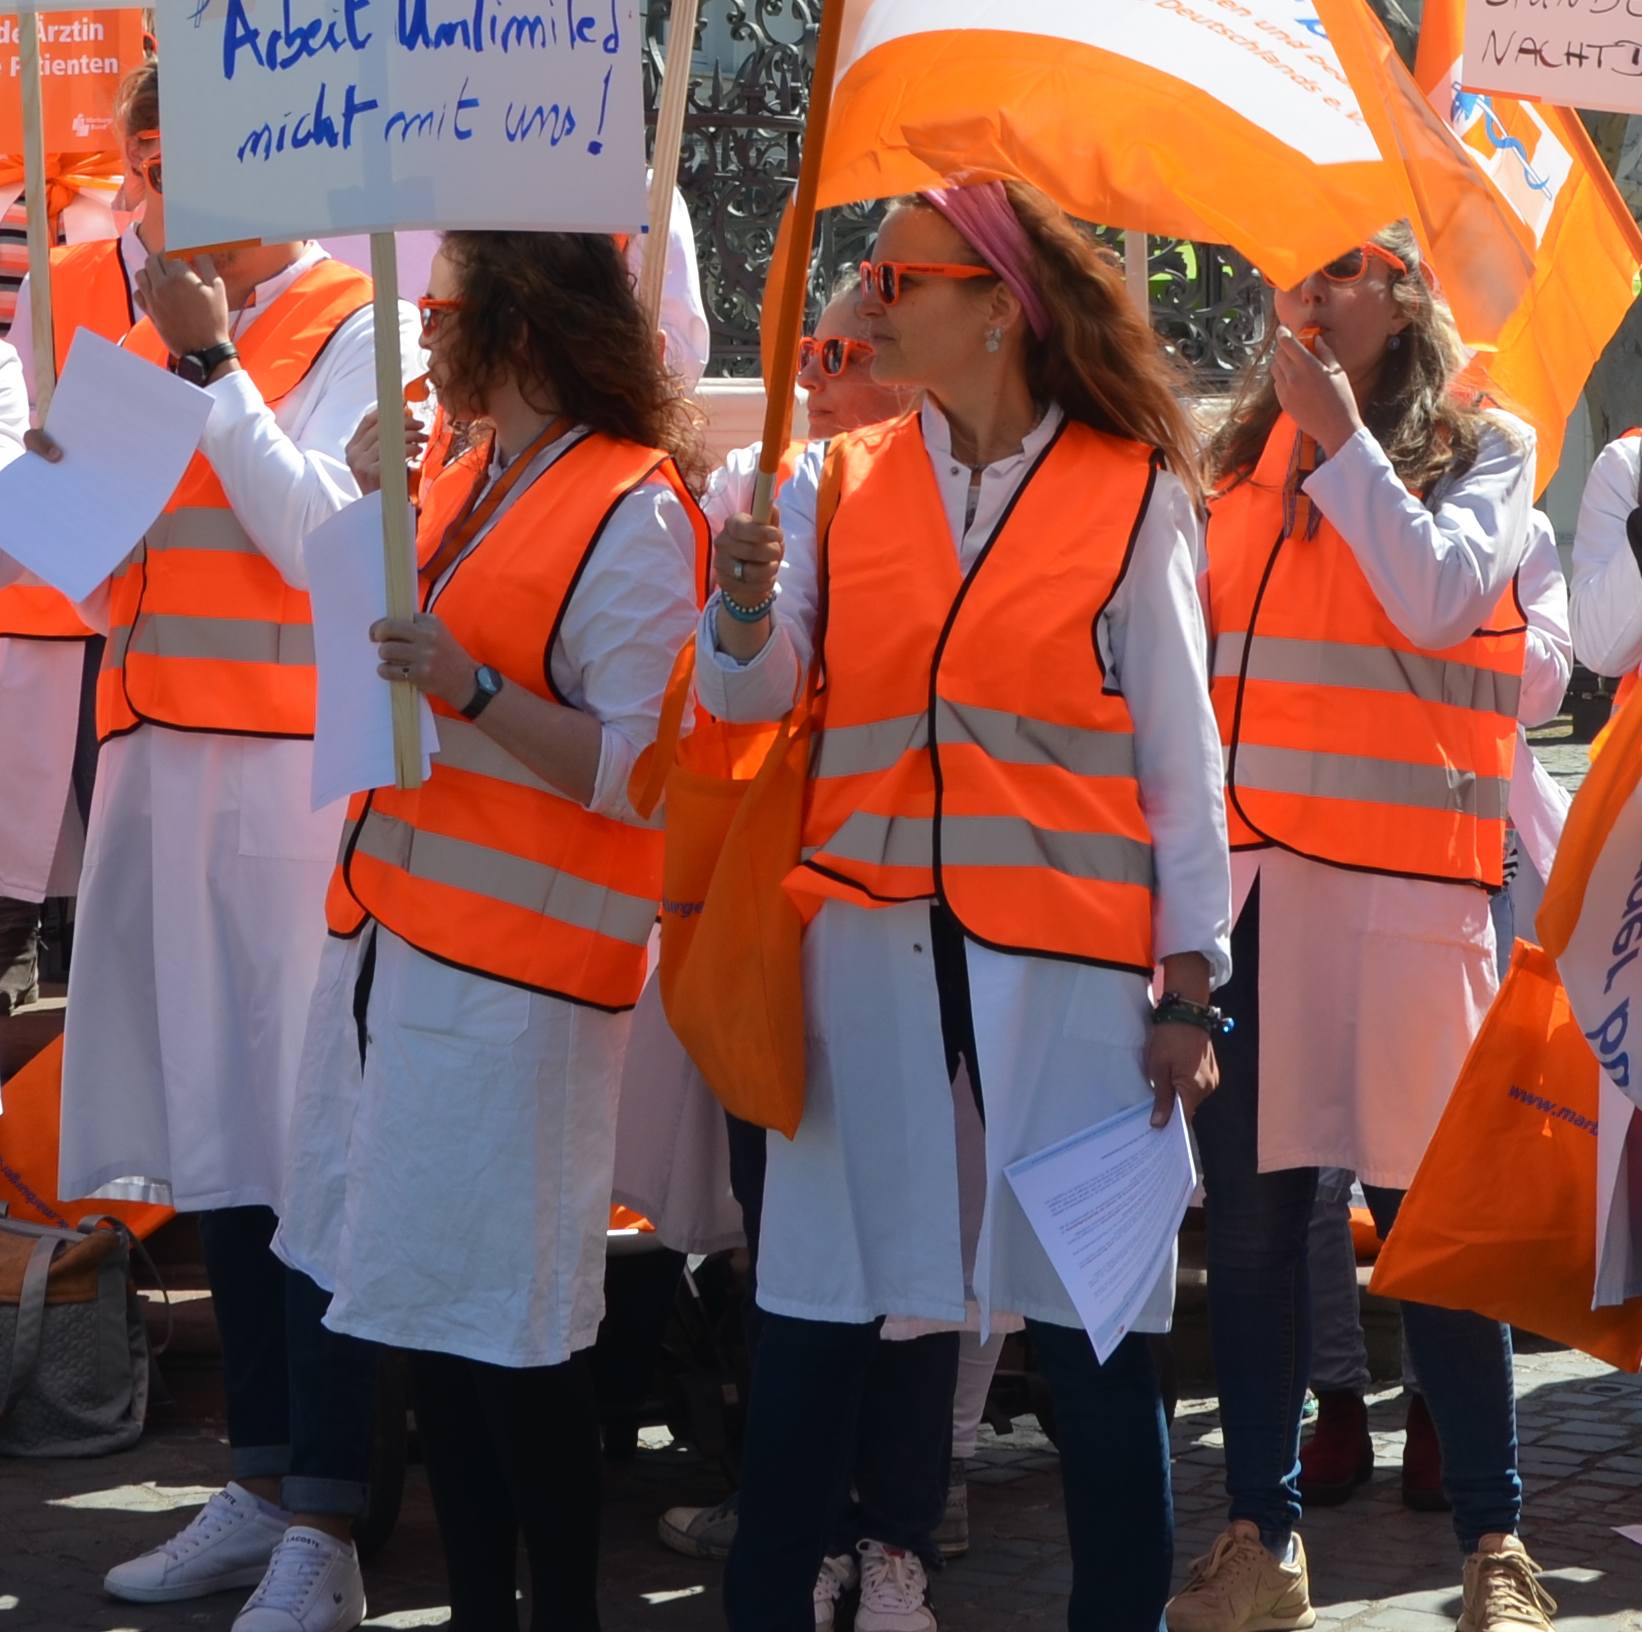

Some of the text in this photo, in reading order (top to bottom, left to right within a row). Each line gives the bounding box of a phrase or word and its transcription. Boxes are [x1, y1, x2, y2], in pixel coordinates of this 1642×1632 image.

[1254, 20, 1312, 49] und
[10, 53, 119, 77] Ptienten
[237, 81, 380, 164] nicht
[383, 75, 481, 143] mit
